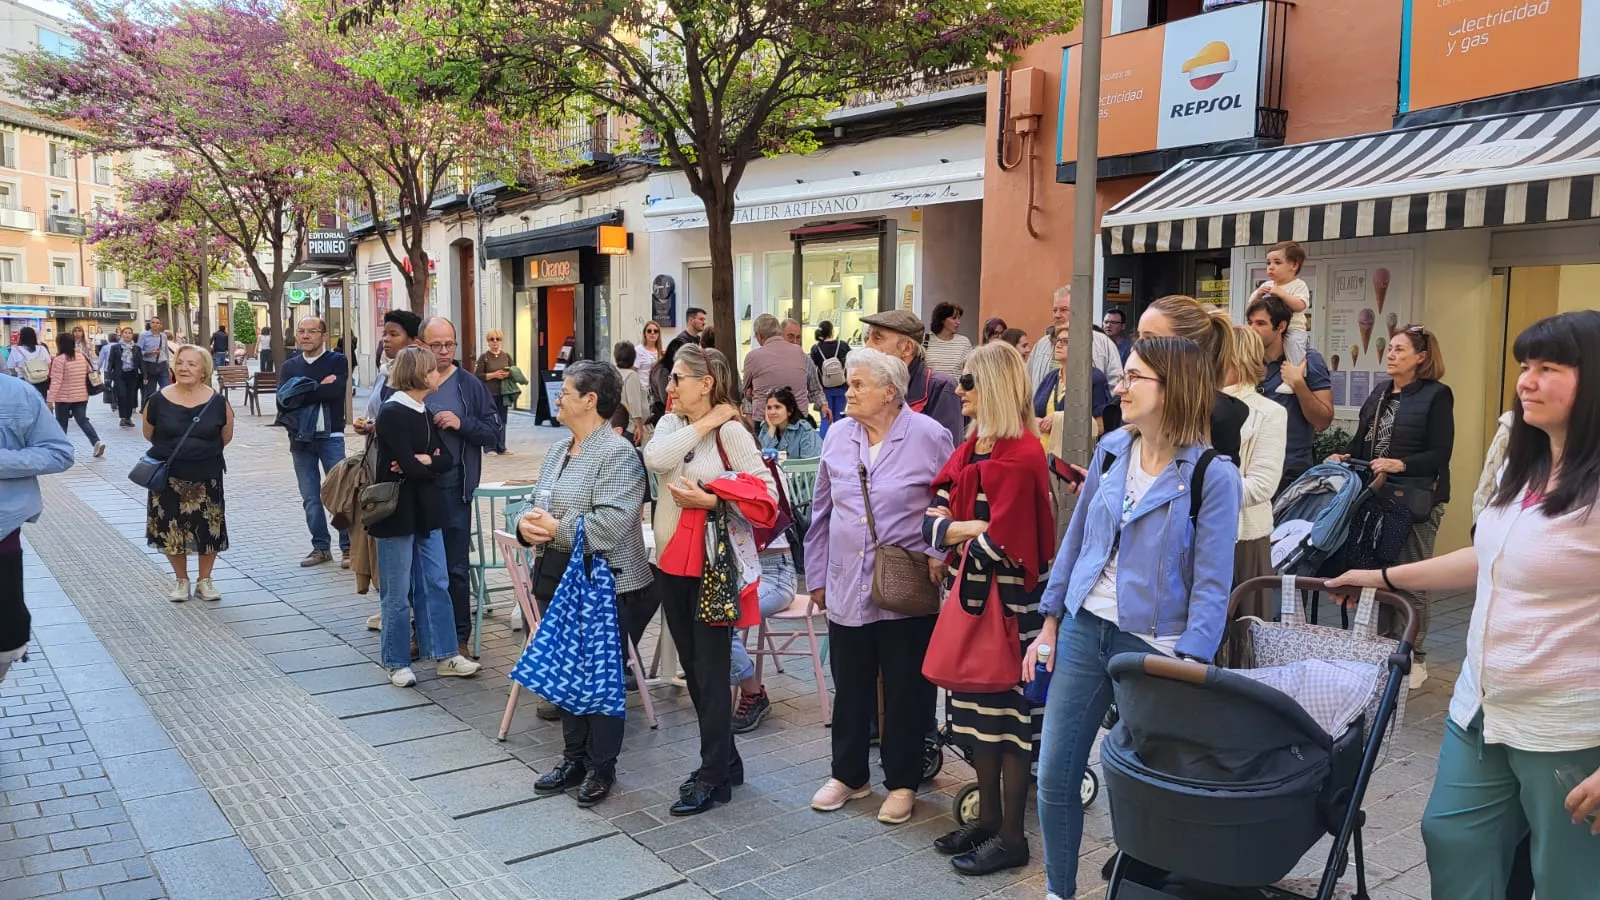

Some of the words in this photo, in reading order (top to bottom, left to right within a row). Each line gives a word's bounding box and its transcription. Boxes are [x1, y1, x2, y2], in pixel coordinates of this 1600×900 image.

[1446, 39, 1457, 57] y
[1460, 32, 1489, 53] gas
[1170, 94, 1242, 118] REPSOL
[735, 205, 779, 222] TALLER
[784, 196, 858, 217] ARTESANO
[308, 231, 346, 239] EDITORIAL
[308, 240, 346, 254] PIRINEO
[541, 258, 570, 280] Orange
